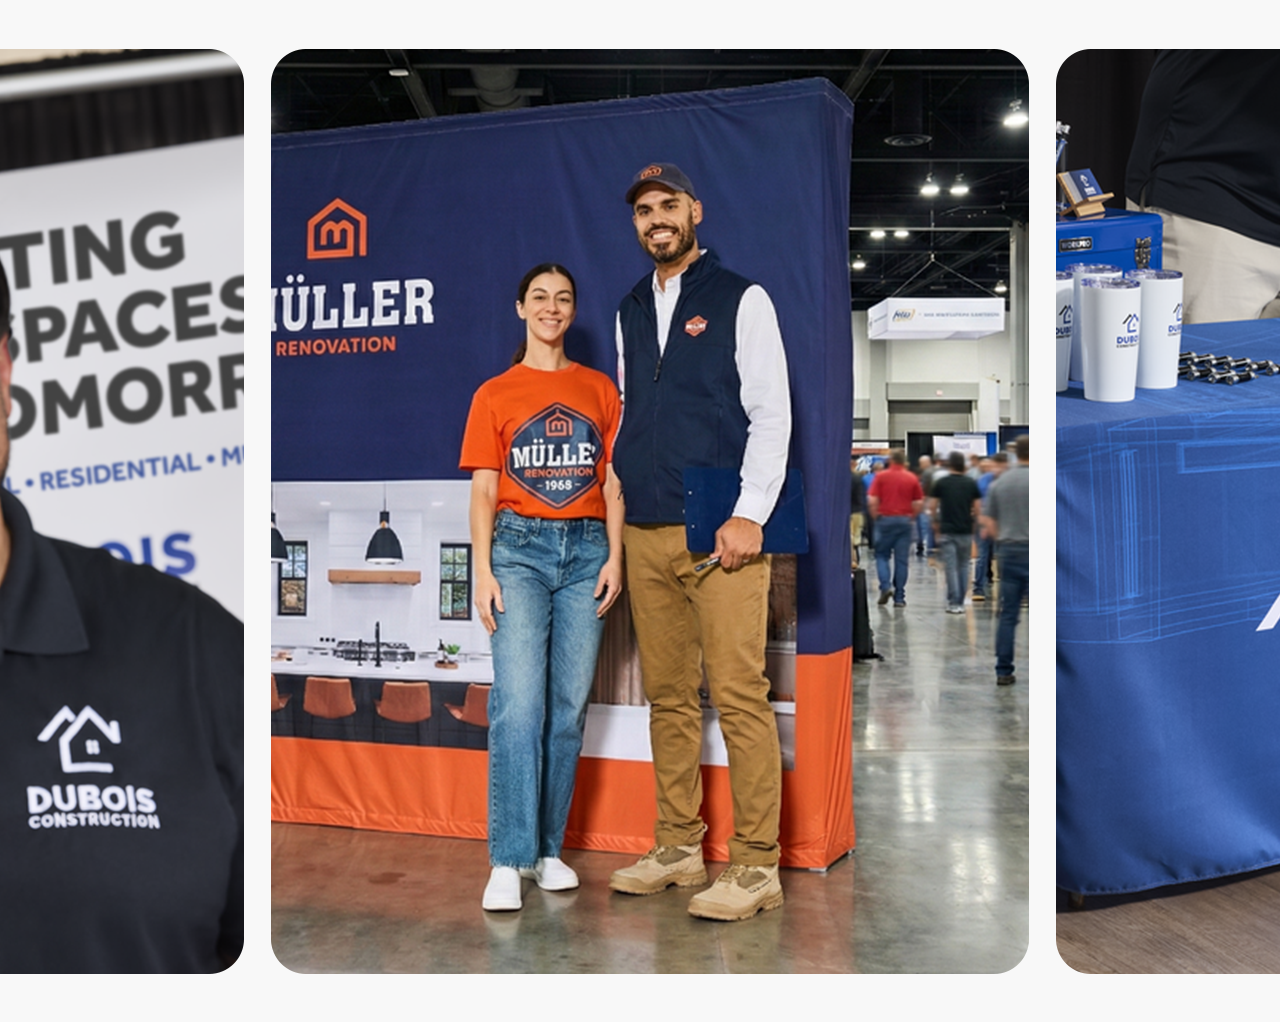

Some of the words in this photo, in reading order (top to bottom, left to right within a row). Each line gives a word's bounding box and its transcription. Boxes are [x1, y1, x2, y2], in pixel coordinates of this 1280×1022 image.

[271, 273, 435, 332] ÜLLER
[276, 335, 397, 356] RENOVATION
[511, 438, 596, 469] MÜLLE
[39, 452, 202, 492] RESIDENTIAL
[524, 467, 594, 478] RENOVATION
[26, 784, 157, 814] DUBOIS
[28, 812, 161, 830] CONSTRUCTION
